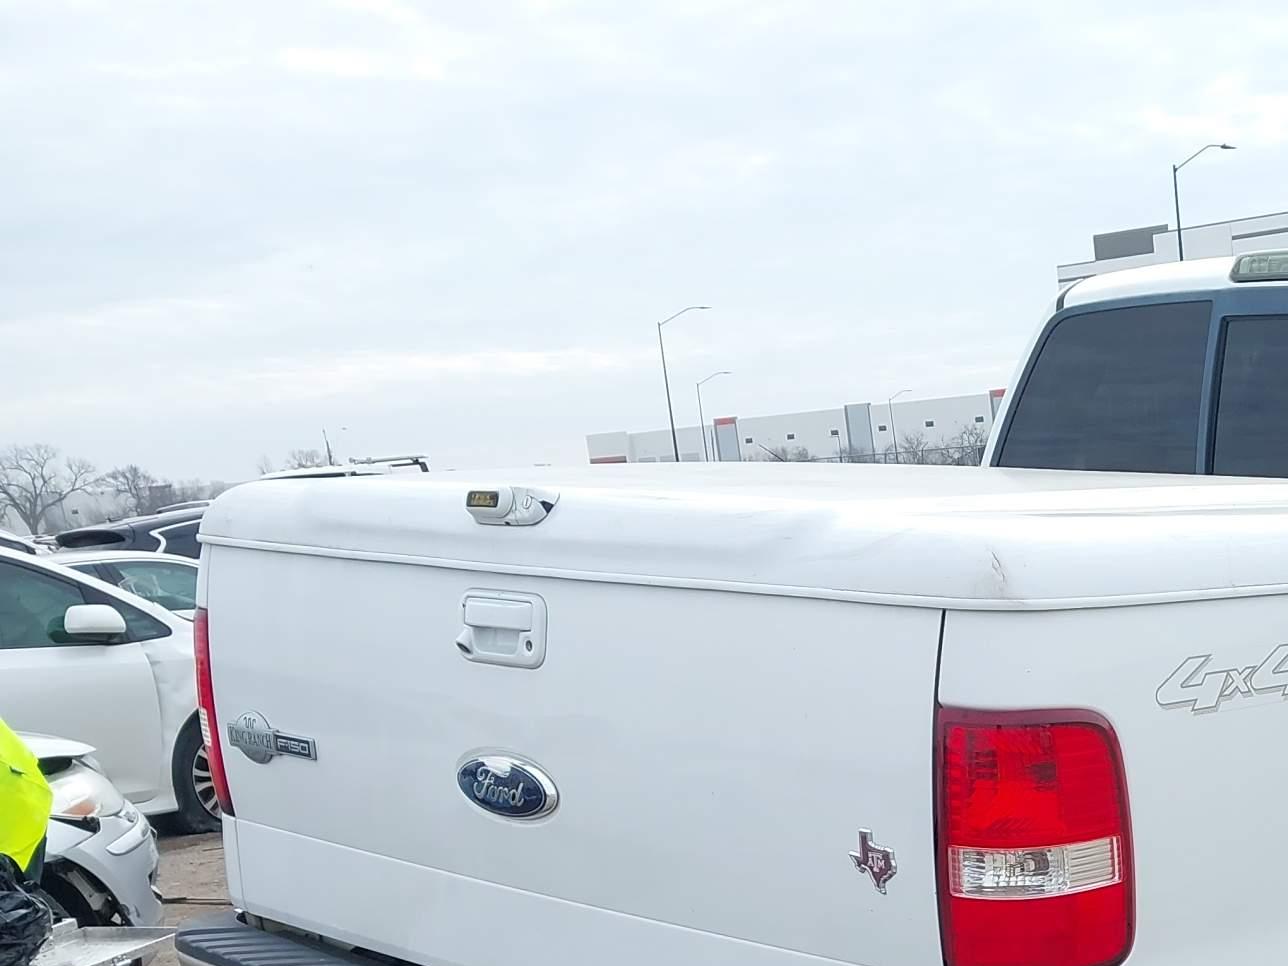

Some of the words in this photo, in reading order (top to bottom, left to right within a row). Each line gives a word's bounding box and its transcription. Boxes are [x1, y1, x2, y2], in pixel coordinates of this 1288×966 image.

[228, 725, 247, 745] KING
[247, 730, 273, 750] RANCH
[473, 765, 525, 807] Ford
